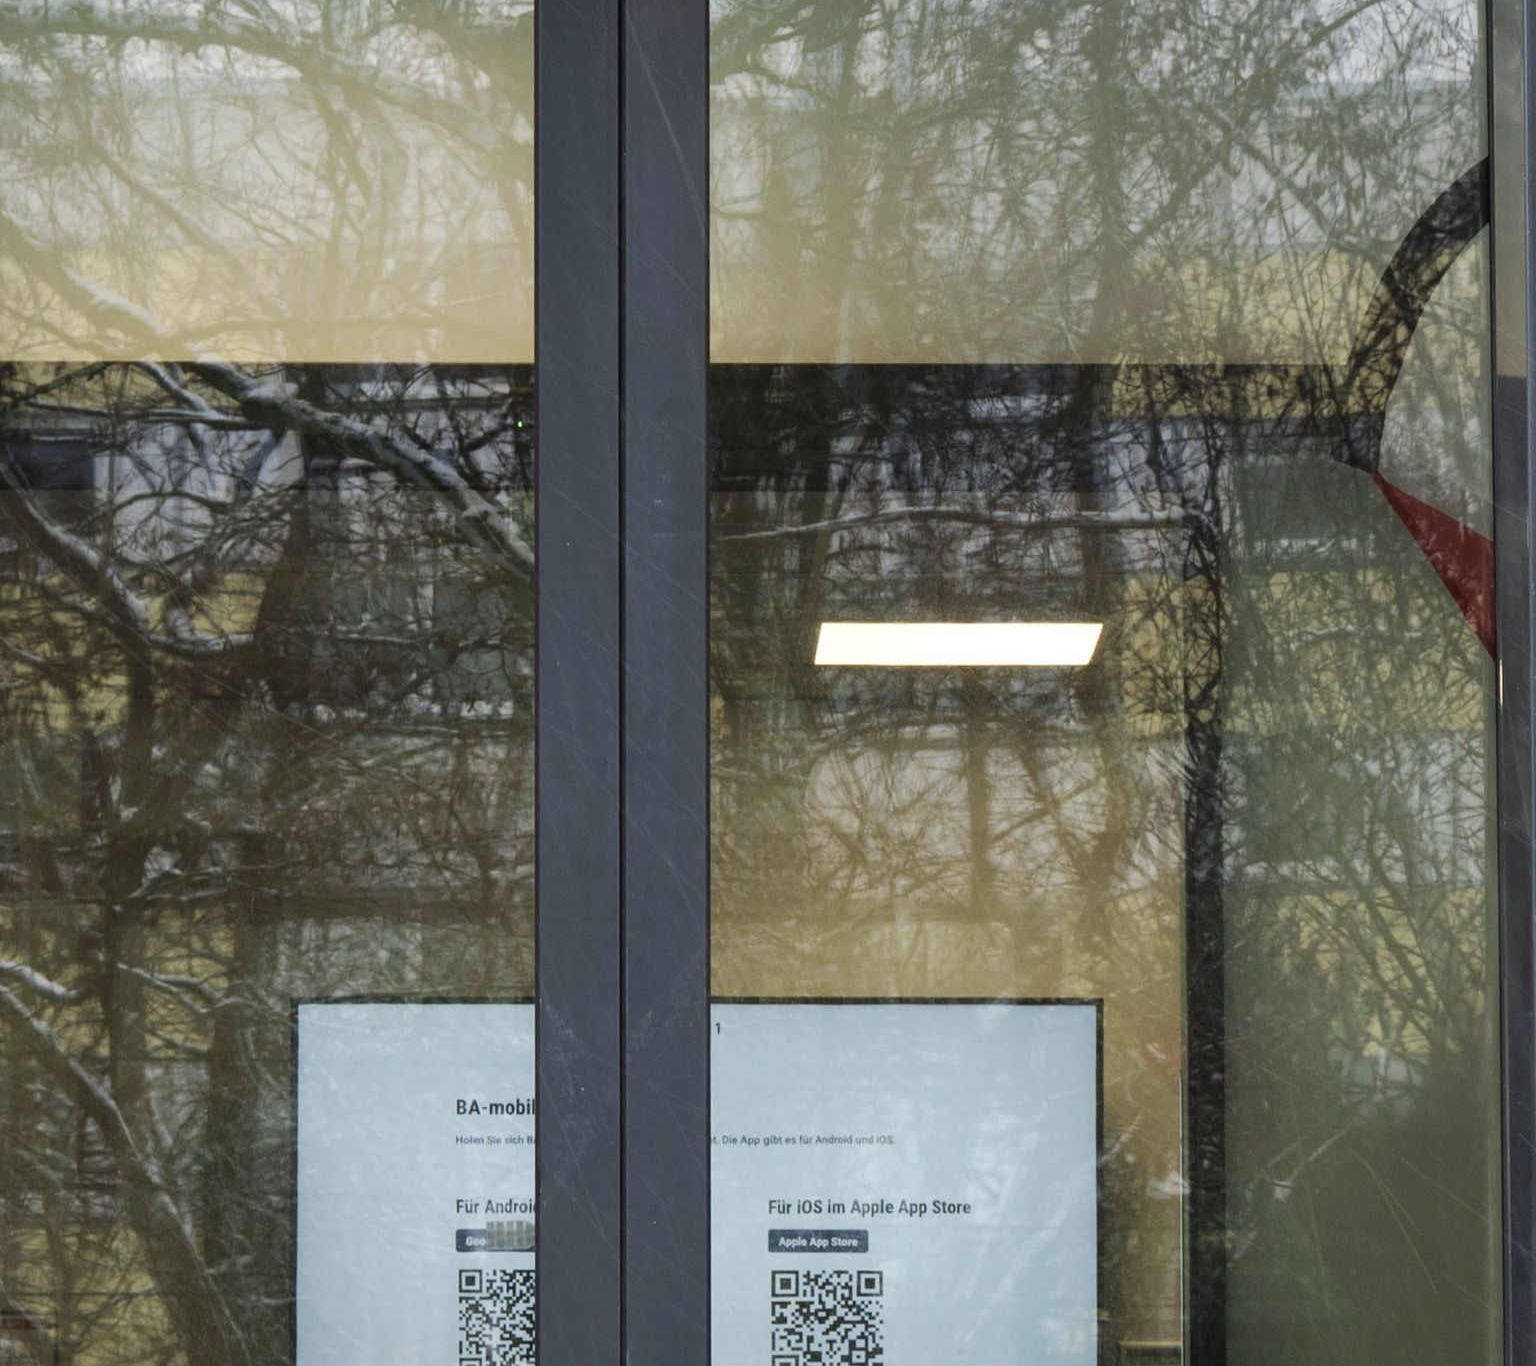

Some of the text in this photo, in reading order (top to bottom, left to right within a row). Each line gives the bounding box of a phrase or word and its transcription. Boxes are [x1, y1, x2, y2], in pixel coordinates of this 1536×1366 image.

[456, 1098, 535, 1115] BA-mobil
[456, 1135, 484, 1145] Holen
[486, 1135, 502, 1145] Sie
[504, 1135, 522, 1145] sich
[722, 1135, 738, 1145] Die
[740, 1135, 761, 1147] App
[763, 1135, 782, 1147] gibt
[785, 1137, 796, 1145] es
[799, 1135, 812, 1145] für
[815, 1135, 853, 1145] Android
[855, 1135, 873, 1145] und
[456, 1198, 479, 1214] Für
[768, 1199, 972, 1217] Für iOS im Apple App Store
[465, 1236, 486, 1246] Goo
[778, 1237, 859, 1248] Apple App Store
